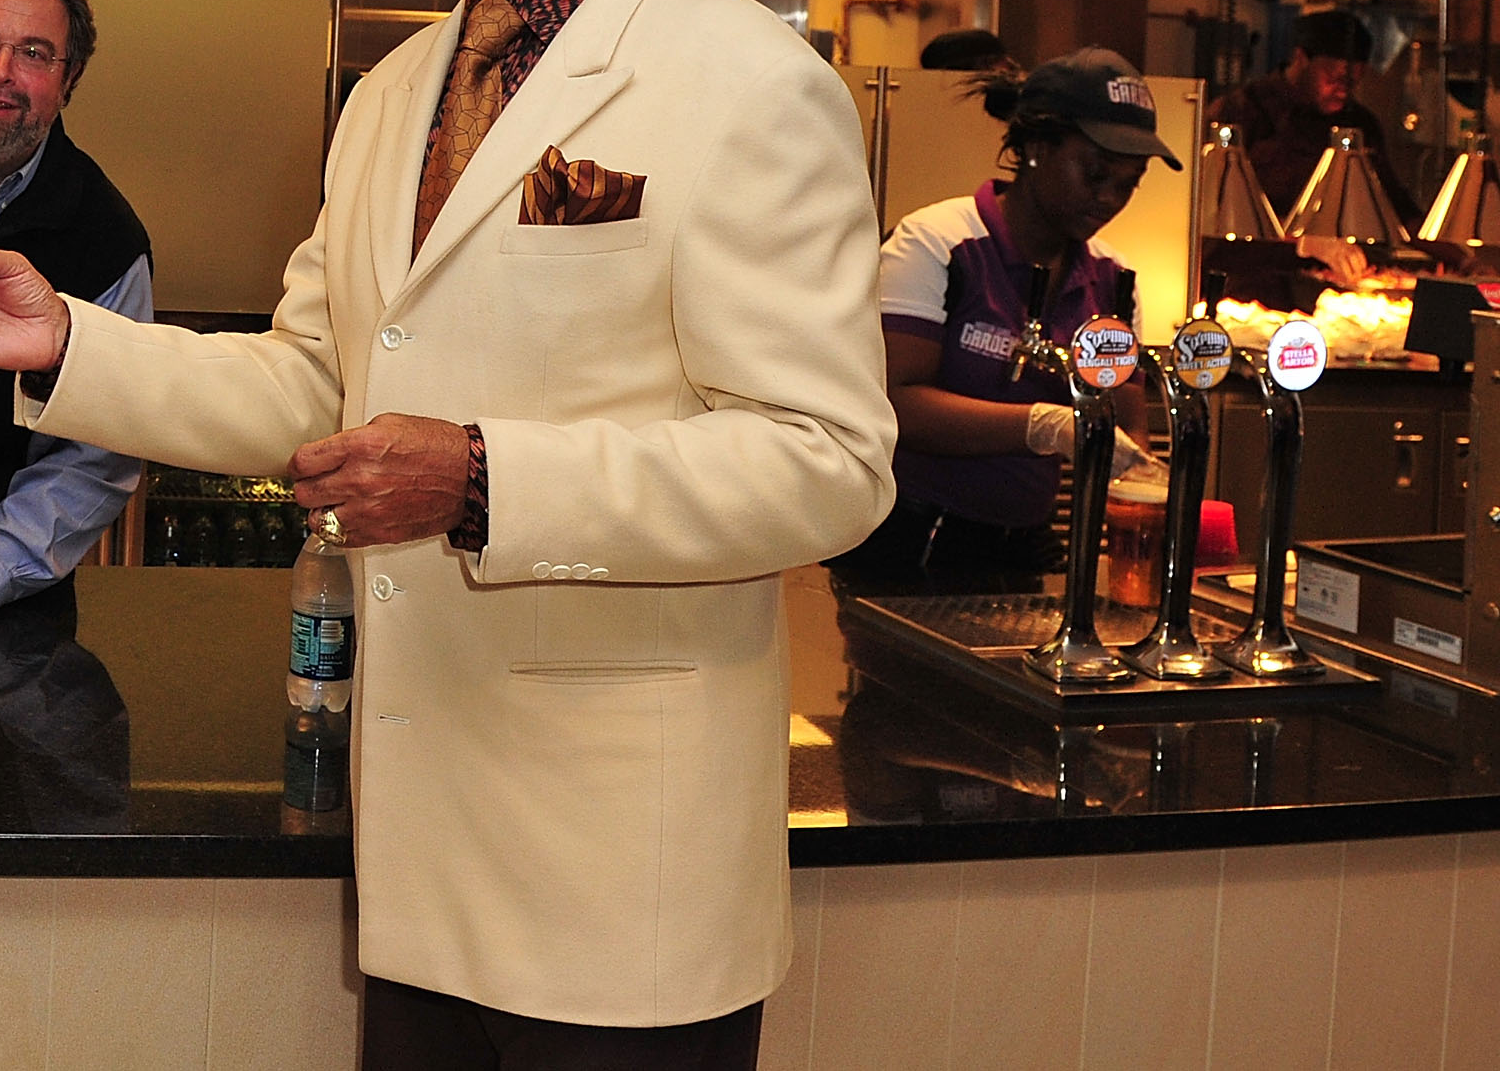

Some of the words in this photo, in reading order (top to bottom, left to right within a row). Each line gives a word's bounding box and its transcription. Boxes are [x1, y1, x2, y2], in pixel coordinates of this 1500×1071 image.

[1284, 349, 1313, 359] STELLA
[1076, 357, 1113, 368] BENGALI
[1284, 357, 1314, 367] ARTOIS
